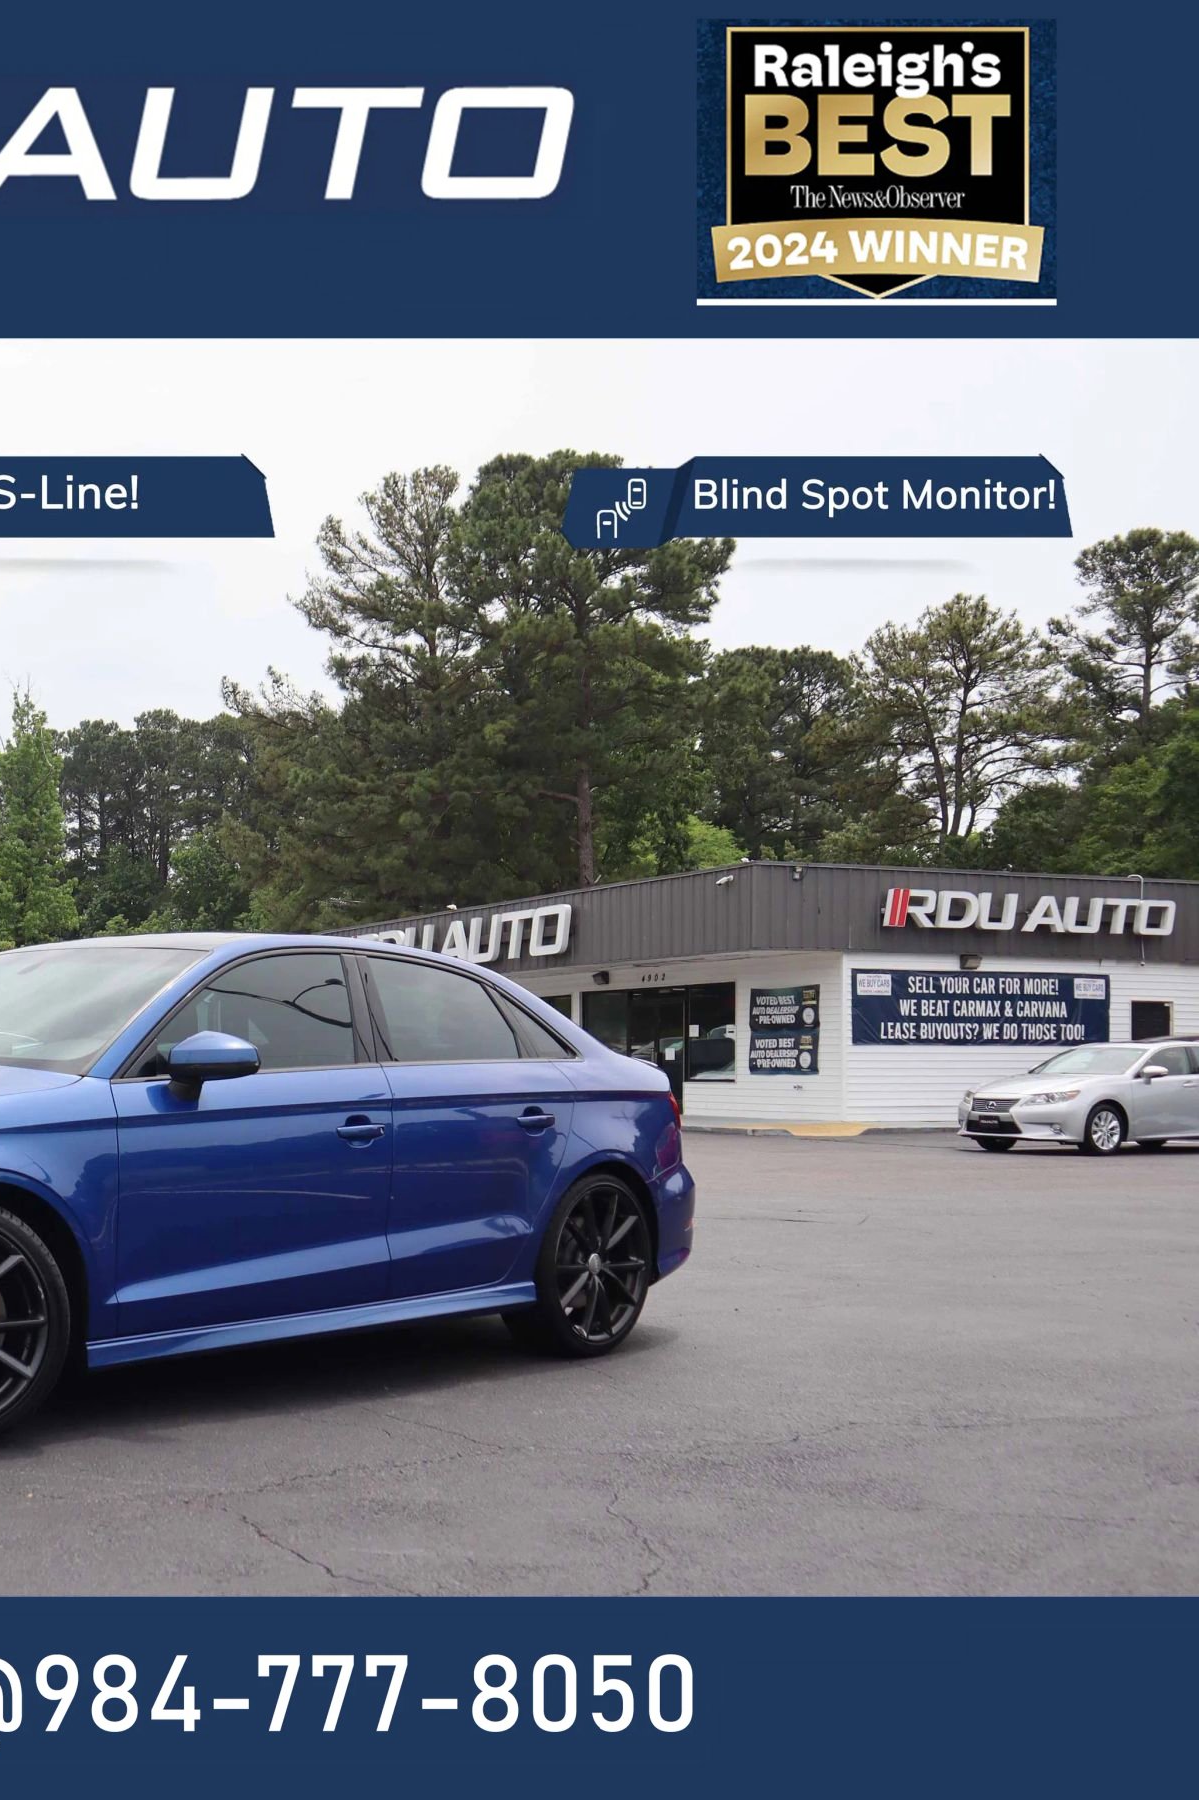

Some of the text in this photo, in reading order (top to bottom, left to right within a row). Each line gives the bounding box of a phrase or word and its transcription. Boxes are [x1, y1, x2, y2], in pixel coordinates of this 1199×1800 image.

[905, 888, 1177, 936] RDU AUTO
[441, 903, 572, 964] AUTO
[908, 976, 1059, 996] SELL YOUR CAR FOR MORE!
[756, 996, 778, 1005] VOTED
[899, 999, 1068, 1018] WE BEAT CARMAX & CARVANA
[880, 1022, 1085, 1041] LEASE BUYOUTS? WE DO THOSE TOO!
[755, 1039, 777, 1048] VOTED
